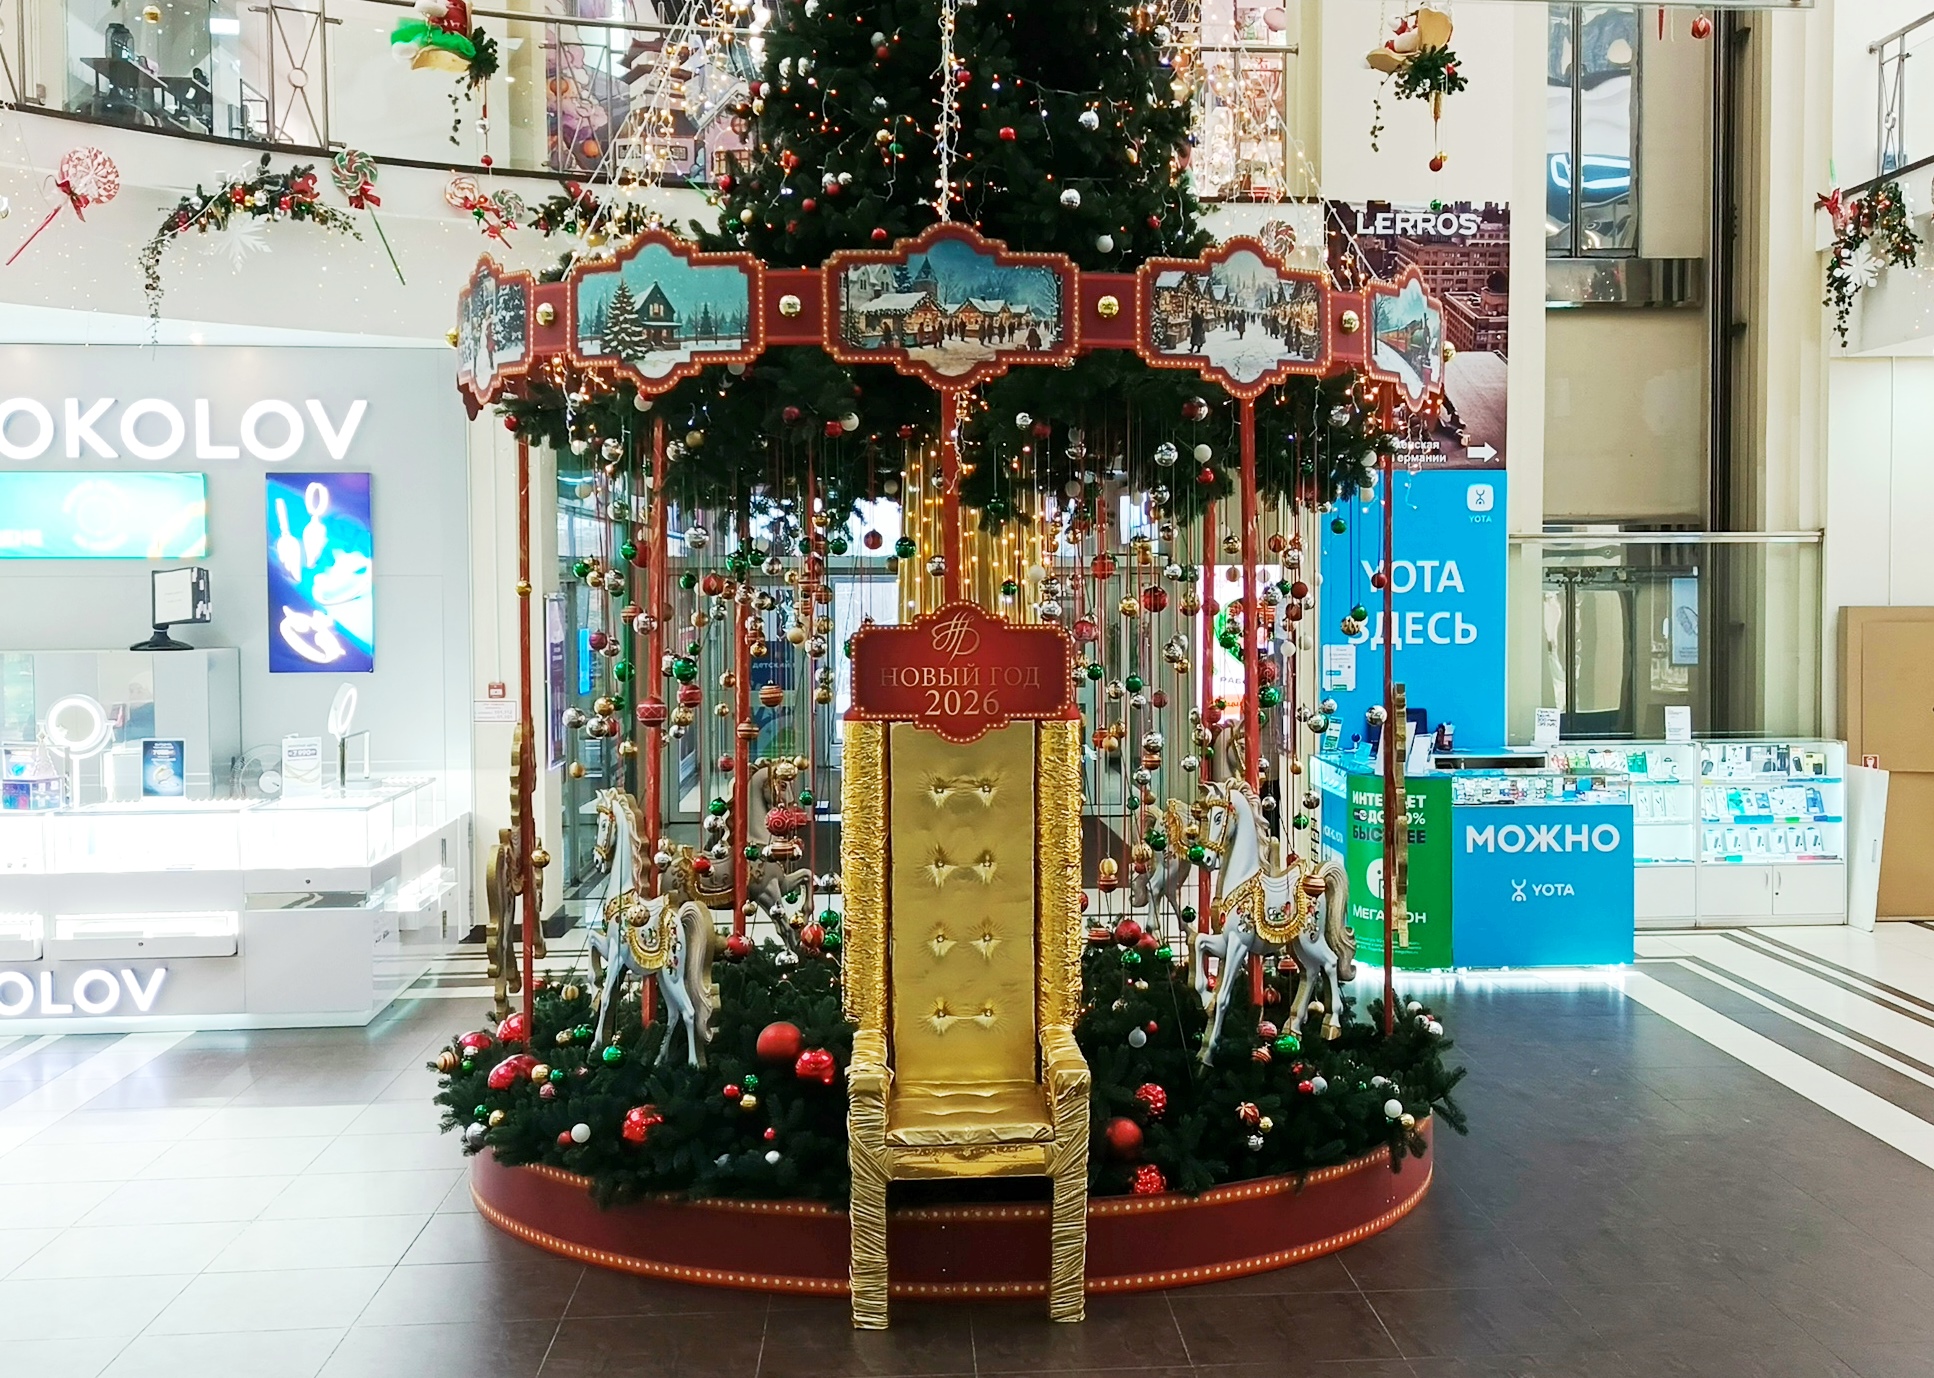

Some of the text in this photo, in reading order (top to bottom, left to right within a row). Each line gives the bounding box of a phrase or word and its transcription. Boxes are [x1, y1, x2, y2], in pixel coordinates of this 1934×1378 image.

[1357, 212, 1479, 236] LERROS
[1469, 515, 1493, 524] YOTA
[1361, 560, 1465, 593] YOTA
[881, 663, 1040, 689] НОВЫЙ ГОД
[924, 689, 1000, 716] 2026
[1352, 790, 1427, 809] ИНТЕЕТ
[1353, 825, 1426, 844] БЫСЕЕ
[1466, 824, 1620, 853] МОЖНО
[1532, 883, 1575, 896] YOTA
[1353, 904, 1427, 924] МЕГАОН
